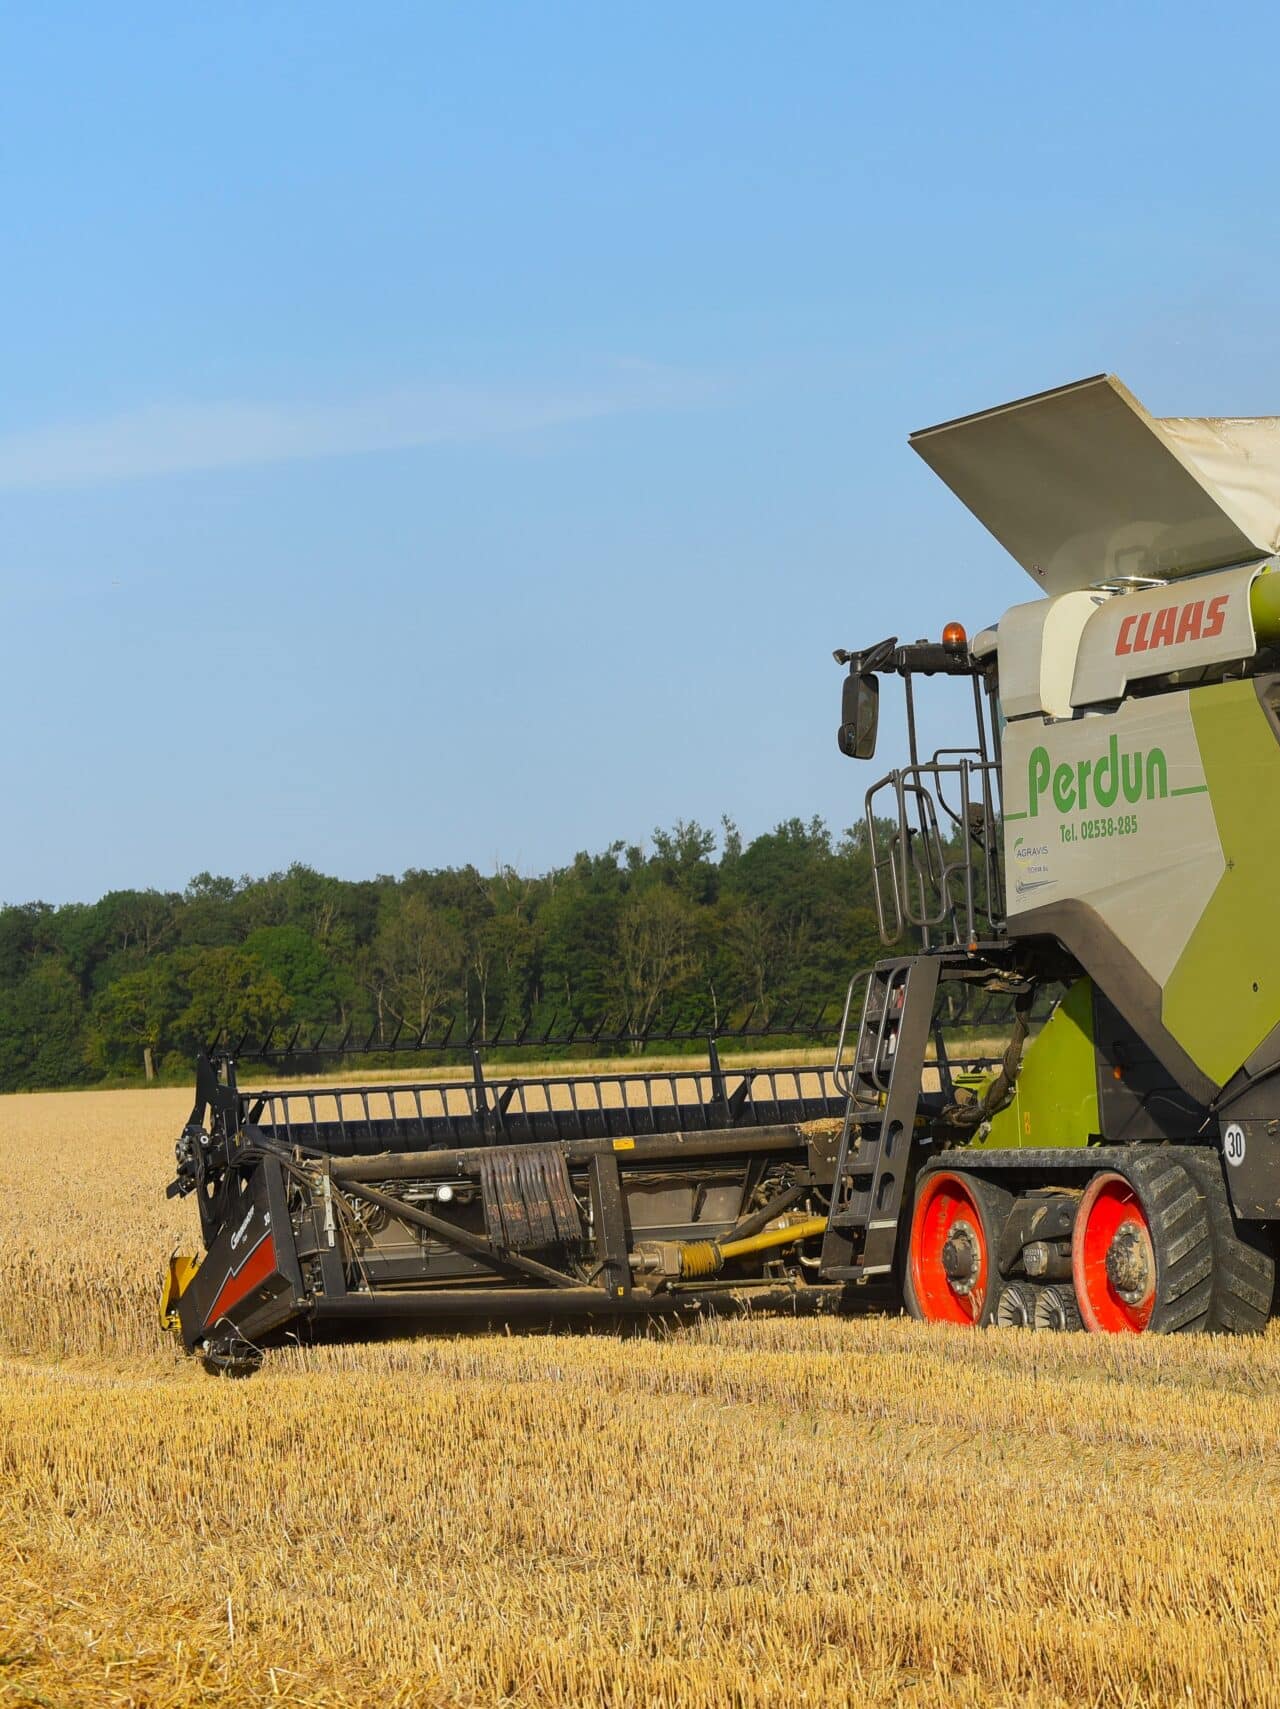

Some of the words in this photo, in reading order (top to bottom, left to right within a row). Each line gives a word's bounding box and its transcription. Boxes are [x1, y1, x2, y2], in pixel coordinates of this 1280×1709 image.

[1115, 595, 1230, 656] CLAAS
[1028, 734, 1169, 818] Perdun
[1060, 823, 1078, 843] Tel.
[1081, 815, 1138, 840] 02538-285
[1017, 846, 1049, 858] AGRAVIS
[1228, 1131, 1242, 1158] 30
